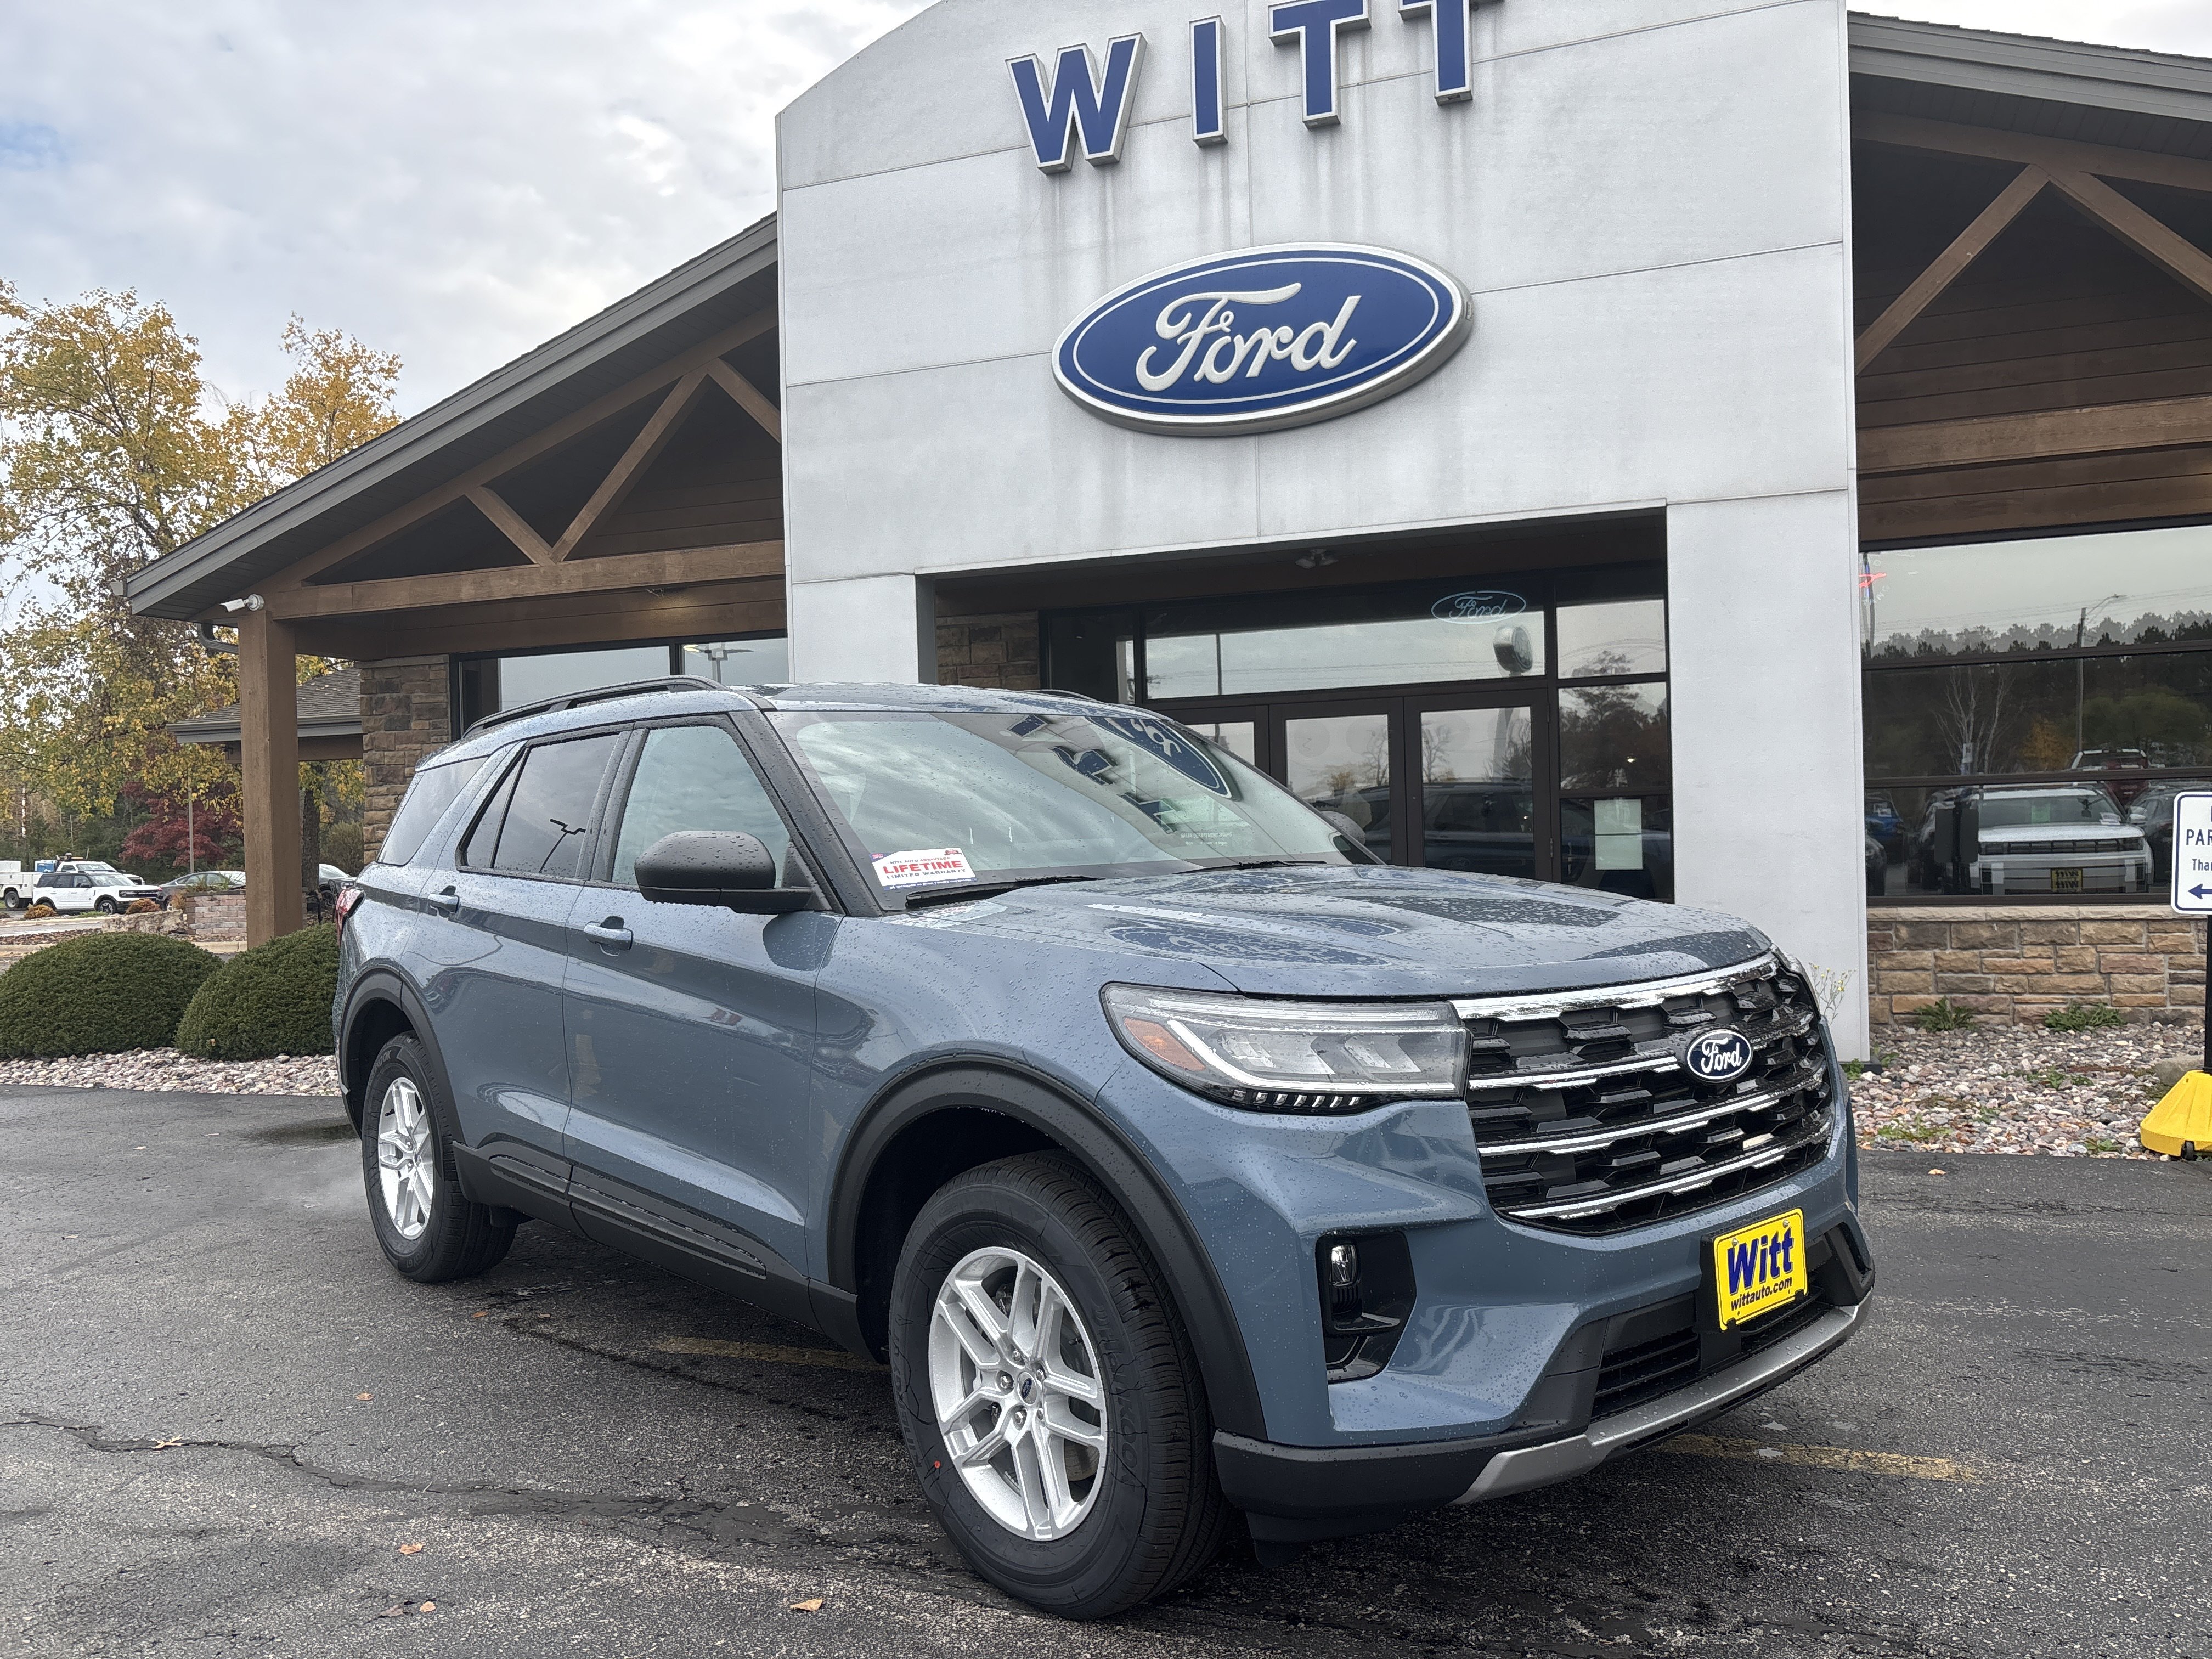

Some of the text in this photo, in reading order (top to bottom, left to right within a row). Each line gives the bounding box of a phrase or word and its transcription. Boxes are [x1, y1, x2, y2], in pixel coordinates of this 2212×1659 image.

[1005, 0, 1503, 173] WITT
[1136, 282, 1362, 392] Ford
[1449, 596, 1508, 619] Ford
[883, 861, 964, 874] LIFETIME
[2192, 859, 2212, 871] Tha
[1701, 1037, 1742, 1074] Ford
[1727, 1227, 1793, 1295] Witt
[1731, 1277, 1792, 1311] wittauto.com
